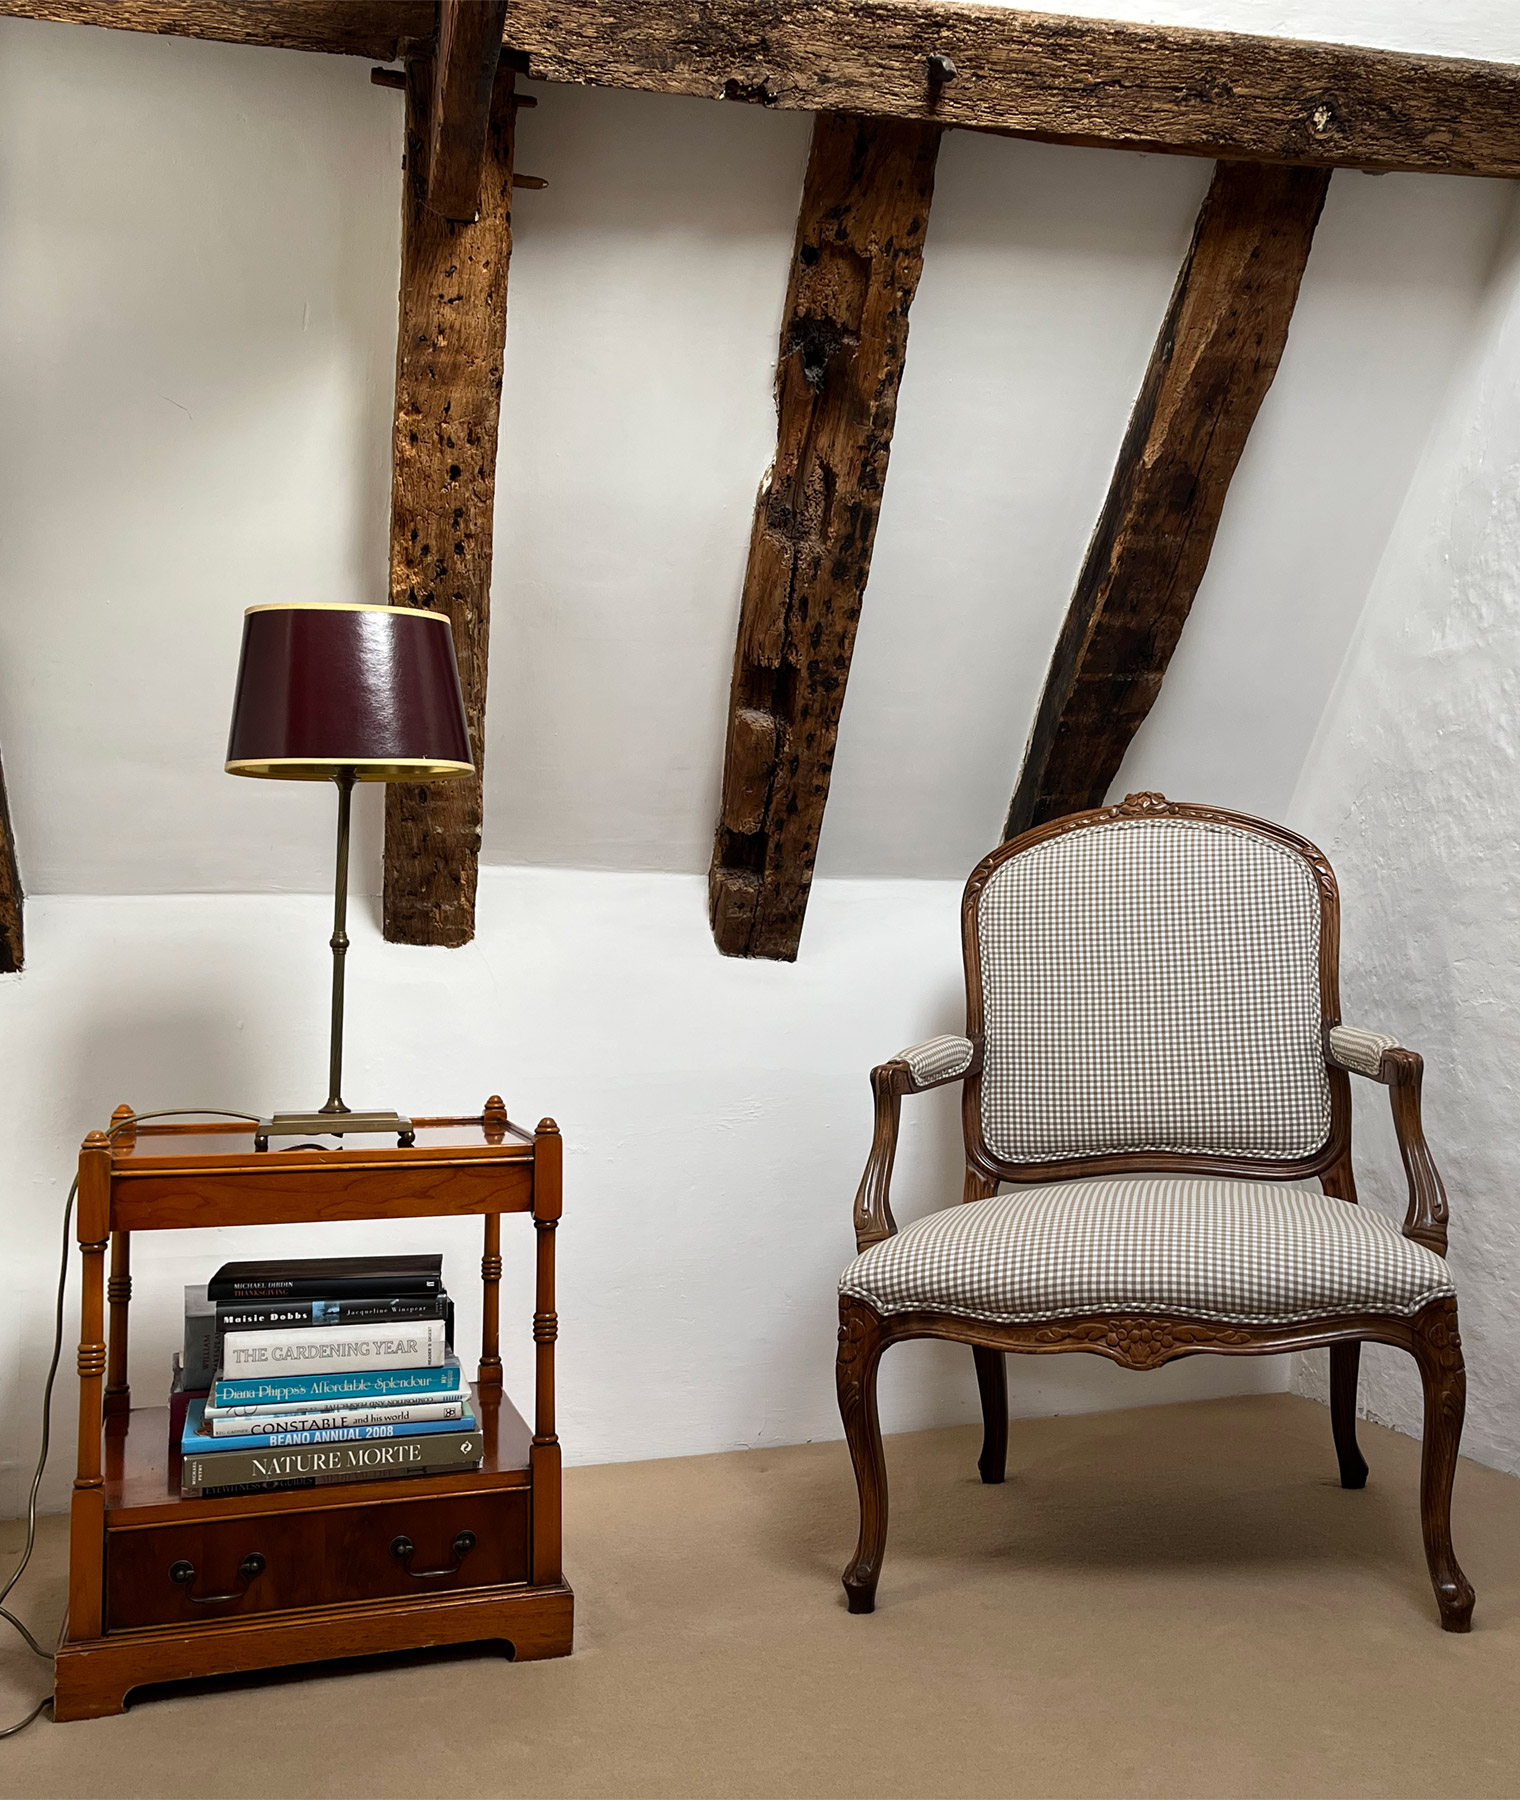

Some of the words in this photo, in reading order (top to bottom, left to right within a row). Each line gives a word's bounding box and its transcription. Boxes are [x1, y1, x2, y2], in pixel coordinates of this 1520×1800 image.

[233, 1281, 266, 1290] MICHAEL
[233, 1288, 289, 1297] THANKSGIVING
[223, 1313, 266, 1324] Maisie
[270, 1311, 308, 1321] Dobbs
[346, 1307, 388, 1317] Jacqueline
[391, 1305, 427, 1314] Winspear
[202, 1335, 210, 1370] WILLIAM
[233, 1348, 268, 1363] THE
[271, 1341, 370, 1361] GARDENING
[373, 1339, 418, 1356] YEAR
[222, 1387, 255, 1400] Diana
[310, 1378, 371, 1395] Affordable
[375, 1375, 432, 1391] Splendour
[251, 1416, 349, 1435] CONSTABLE
[352, 1415, 368, 1425] and
[370, 1414, 383, 1423] his
[384, 1411, 410, 1422] world
[269, 1432, 310, 1447] BEANO
[313, 1428, 363, 1443] ANNUAL
[365, 1426, 394, 1439] 2008
[251, 1451, 342, 1476] NATURE
[346, 1444, 422, 1468] MORTE
[206, 1483, 261, 1496] EYEWITNESS
[279, 1478, 313, 1488] GUIDES
